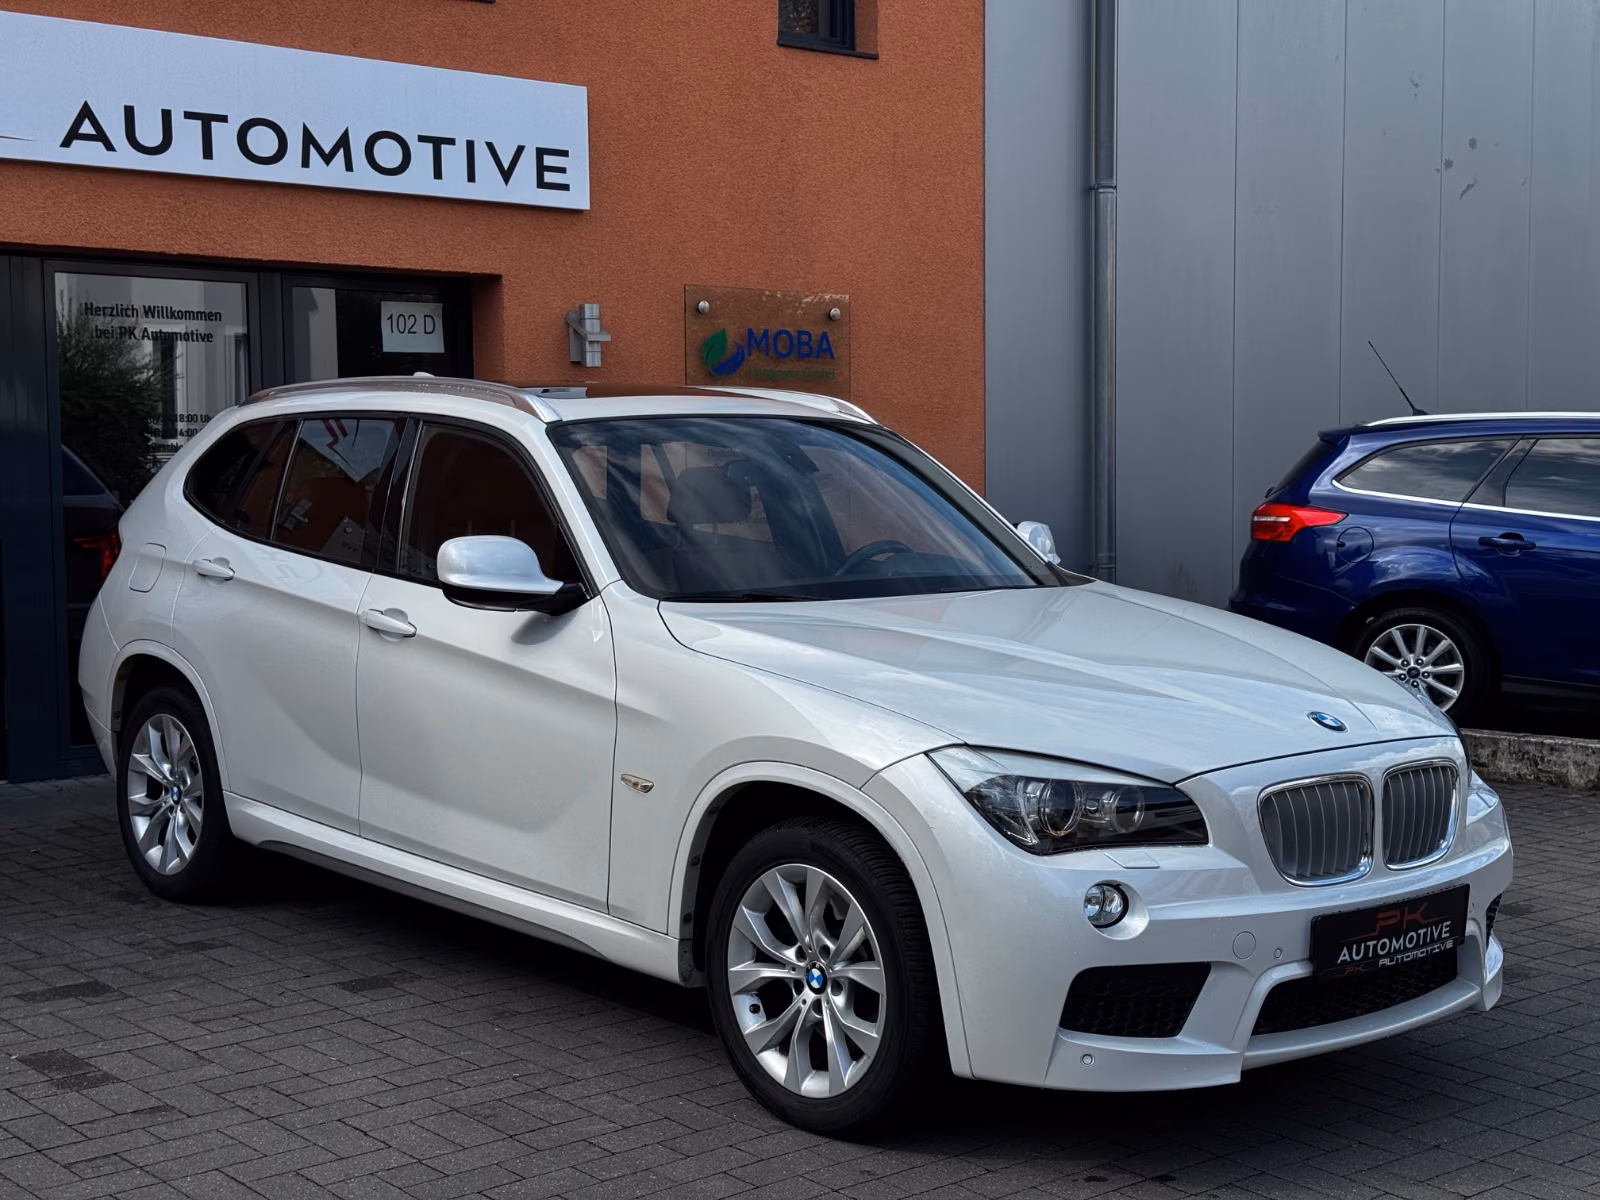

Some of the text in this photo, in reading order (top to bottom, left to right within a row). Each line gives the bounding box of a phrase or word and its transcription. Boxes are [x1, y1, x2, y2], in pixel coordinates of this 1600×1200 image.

[59, 100, 571, 192] AUTOMOTIVE
[84, 302, 222, 322] Herzlich Willkommen
[387, 313, 436, 335] 102 D
[94, 326, 214, 343] bei PK Automotive
[746, 327, 835, 360] MOBA
[1376, 901, 1429, 935] PK
[1337, 921, 1452, 964] AUTOMOTIVE
[1379, 940, 1453, 968] AUTOMOTIVE
